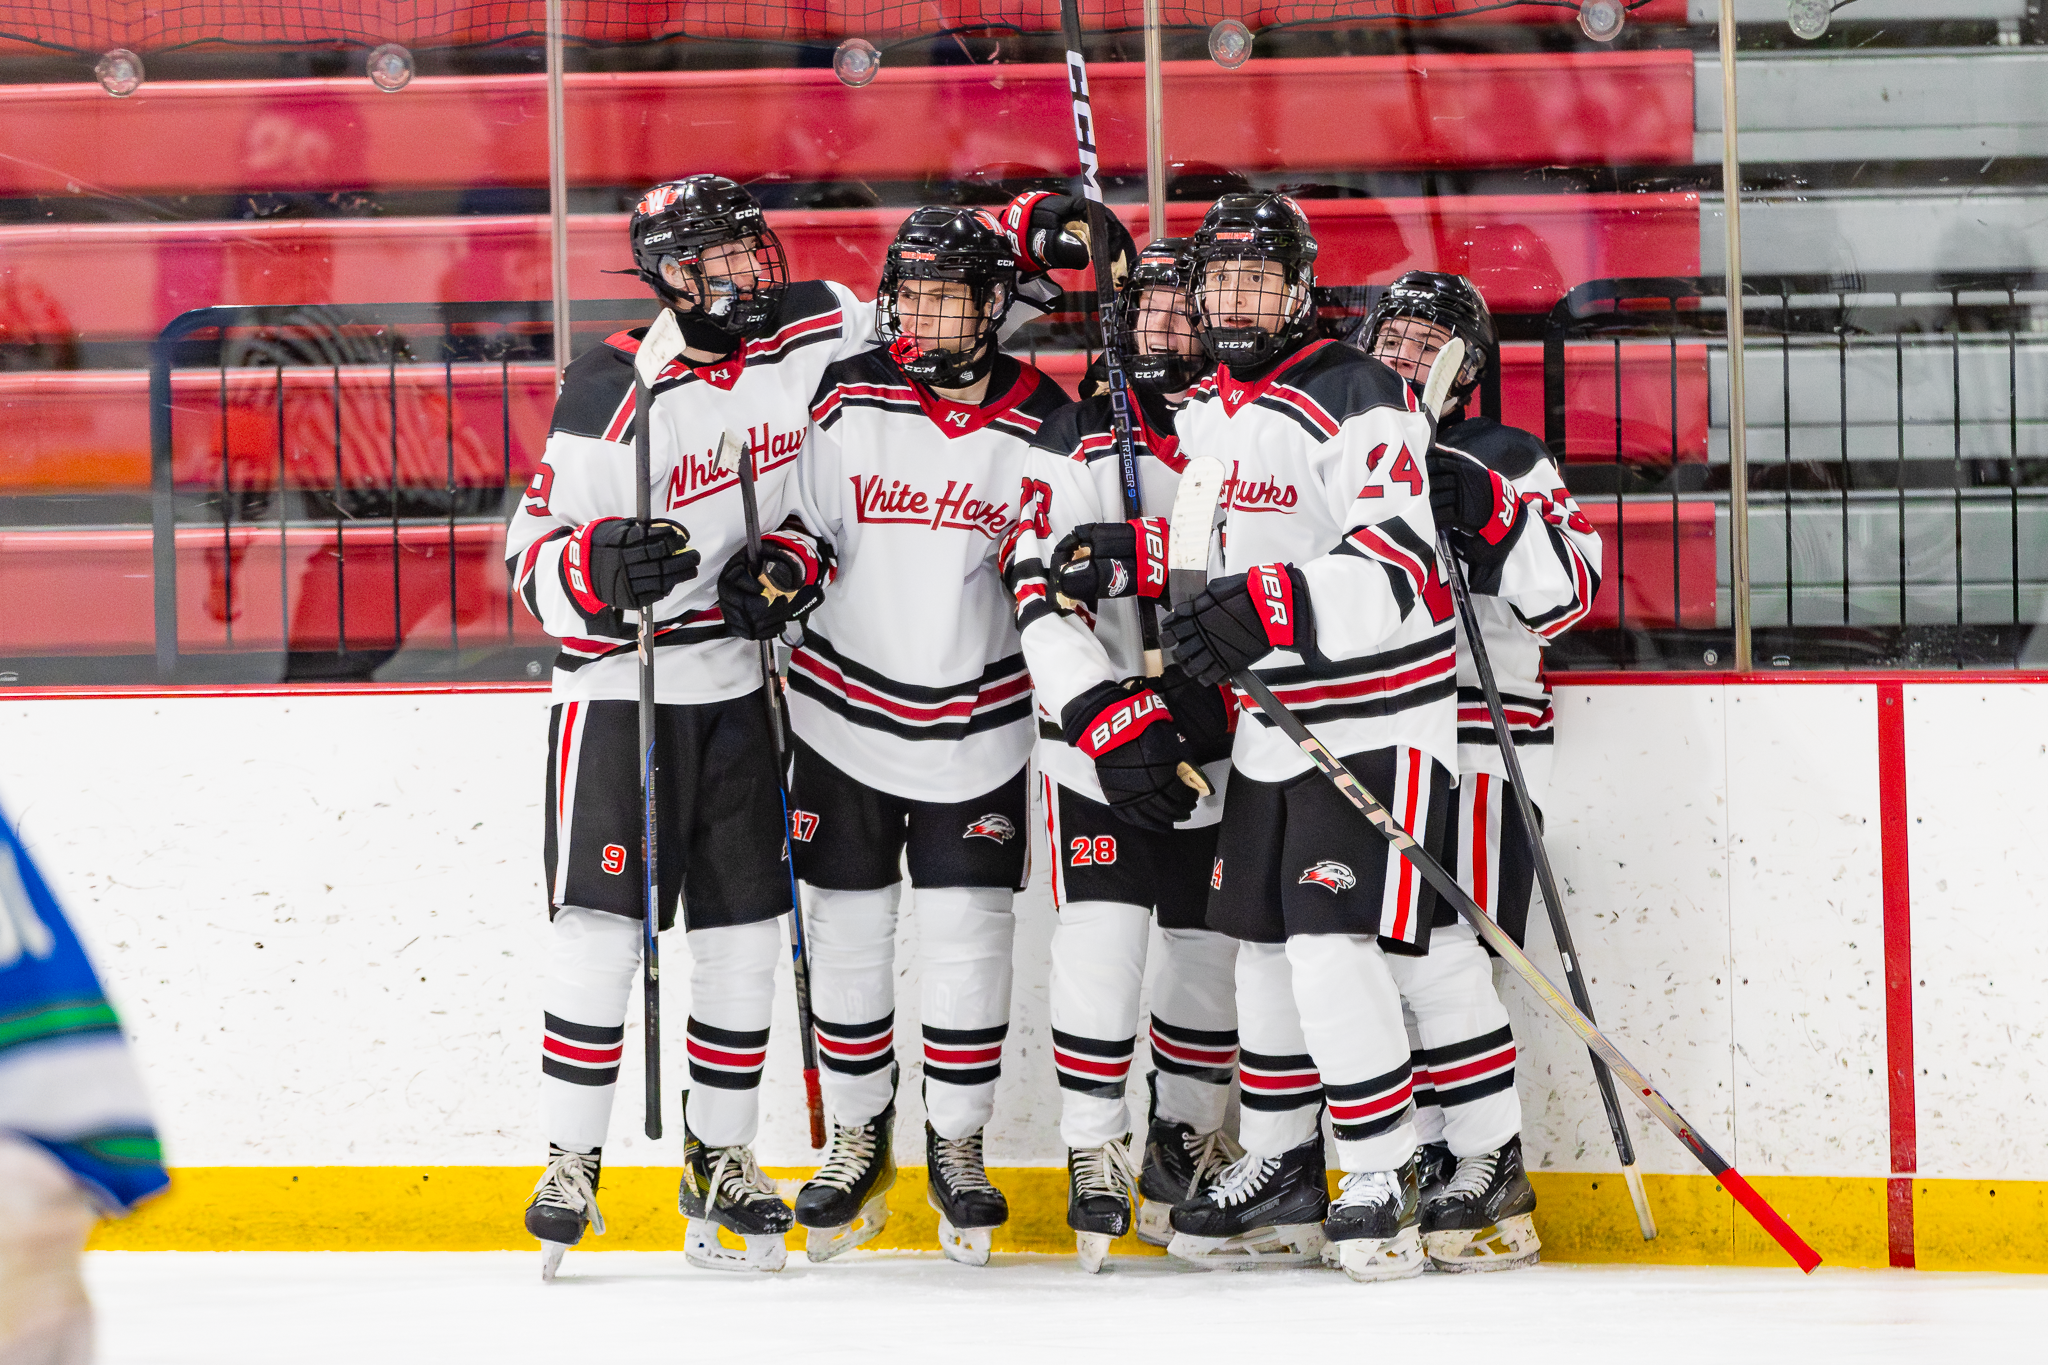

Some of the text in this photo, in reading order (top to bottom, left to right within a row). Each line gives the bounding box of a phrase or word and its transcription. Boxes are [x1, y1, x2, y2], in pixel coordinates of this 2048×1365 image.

[1066, 50, 1103, 203] CCM
[735, 207, 760, 220] CCM
[644, 231, 672, 246] CCM
[997, 259, 1015, 268] CCM
[1394, 289, 1435, 300] CCM
[1218, 340, 1254, 350] CCM
[904, 364, 937, 374] CCM
[1134, 369, 1166, 379] CCM
[747, 422, 807, 482] Haw
[1121, 437, 1136, 487] TRIGGER
[1357, 441, 1424, 499] 24
[525, 461, 555, 517] 9
[849, 474, 930, 523] White
[1127, 488, 1136, 498] 9
[1299, 737, 1417, 851] CCM
[792, 809, 820, 843] 17
[601, 843, 627, 875] 9
[1070, 835, 1117, 867] 28
[1211, 858, 1224, 890] 4
